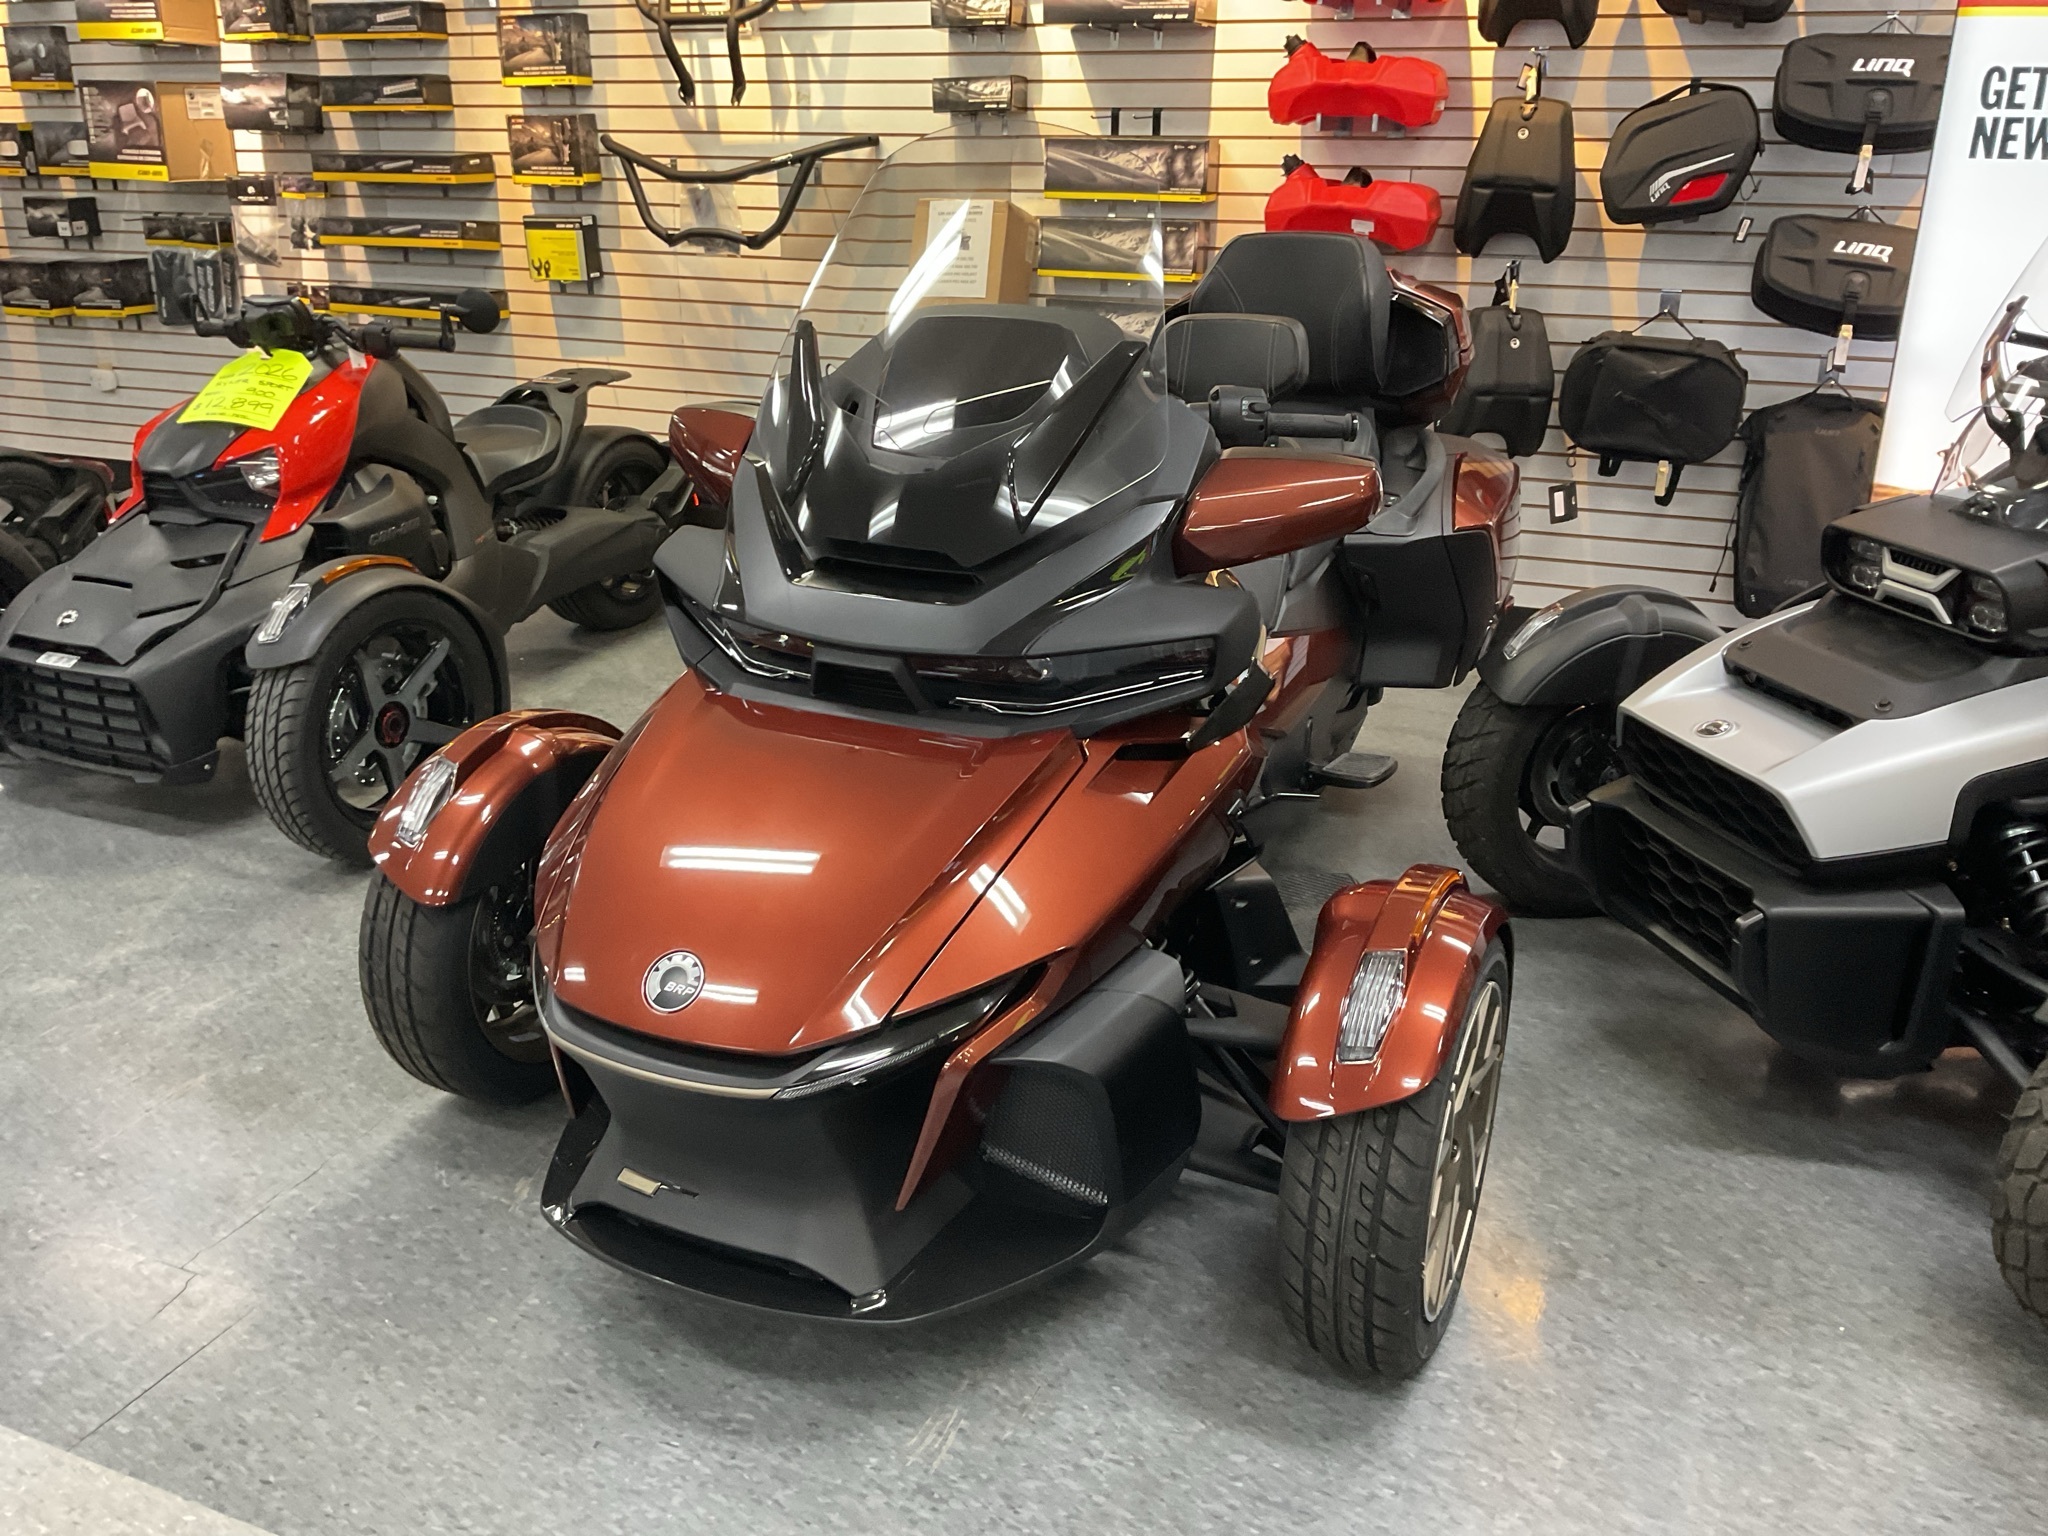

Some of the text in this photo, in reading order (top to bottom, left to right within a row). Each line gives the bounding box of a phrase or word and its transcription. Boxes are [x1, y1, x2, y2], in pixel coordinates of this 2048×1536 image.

[1980, 65, 2048, 110] GET
[1968, 116, 2048, 160] NEW
[239, 363, 298, 381] 2026
[246, 387, 276, 398] 900
[663, 981, 696, 995] BRP
